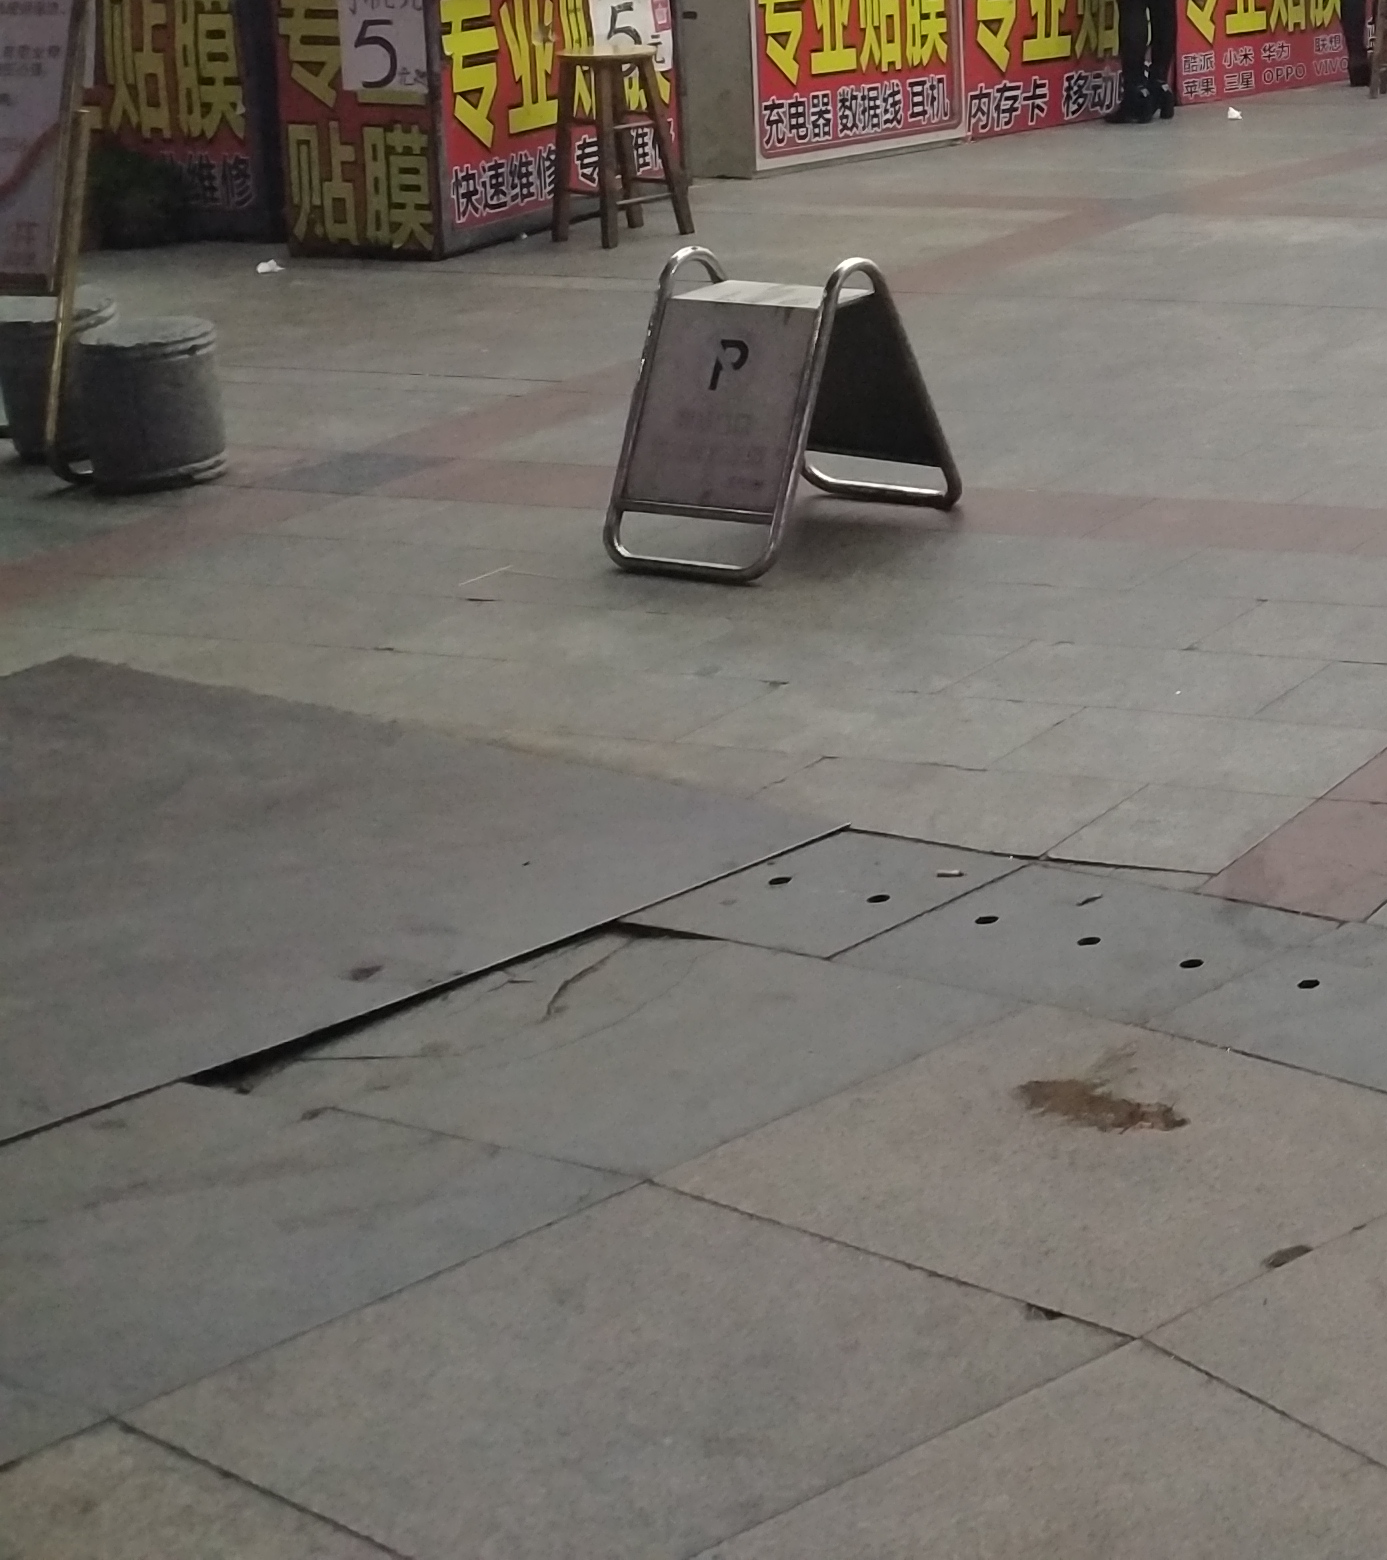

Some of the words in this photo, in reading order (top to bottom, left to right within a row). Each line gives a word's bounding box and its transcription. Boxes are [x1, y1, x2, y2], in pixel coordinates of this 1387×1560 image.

[353, 18, 399, 89] 5
[1181, 50, 1216, 77] 酷派
[1222, 43, 1254, 69] 小米
[1261, 40, 1292, 64] 华为
[1314, 32, 1344, 54] 联想
[1182, 74, 1217, 99] 苹果
[1223, 69, 1255, 94] 三星
[1262, 62, 1307, 86] OPPO
[762, 90, 834, 149] 充电器
[836, 80, 904, 136] 数据线
[907, 74, 951, 123] 耳机
[967, 75, 1051, 137] 内存卡
[1062, 69, 1125, 121] 移动
[287, 120, 436, 250] 贴膜
